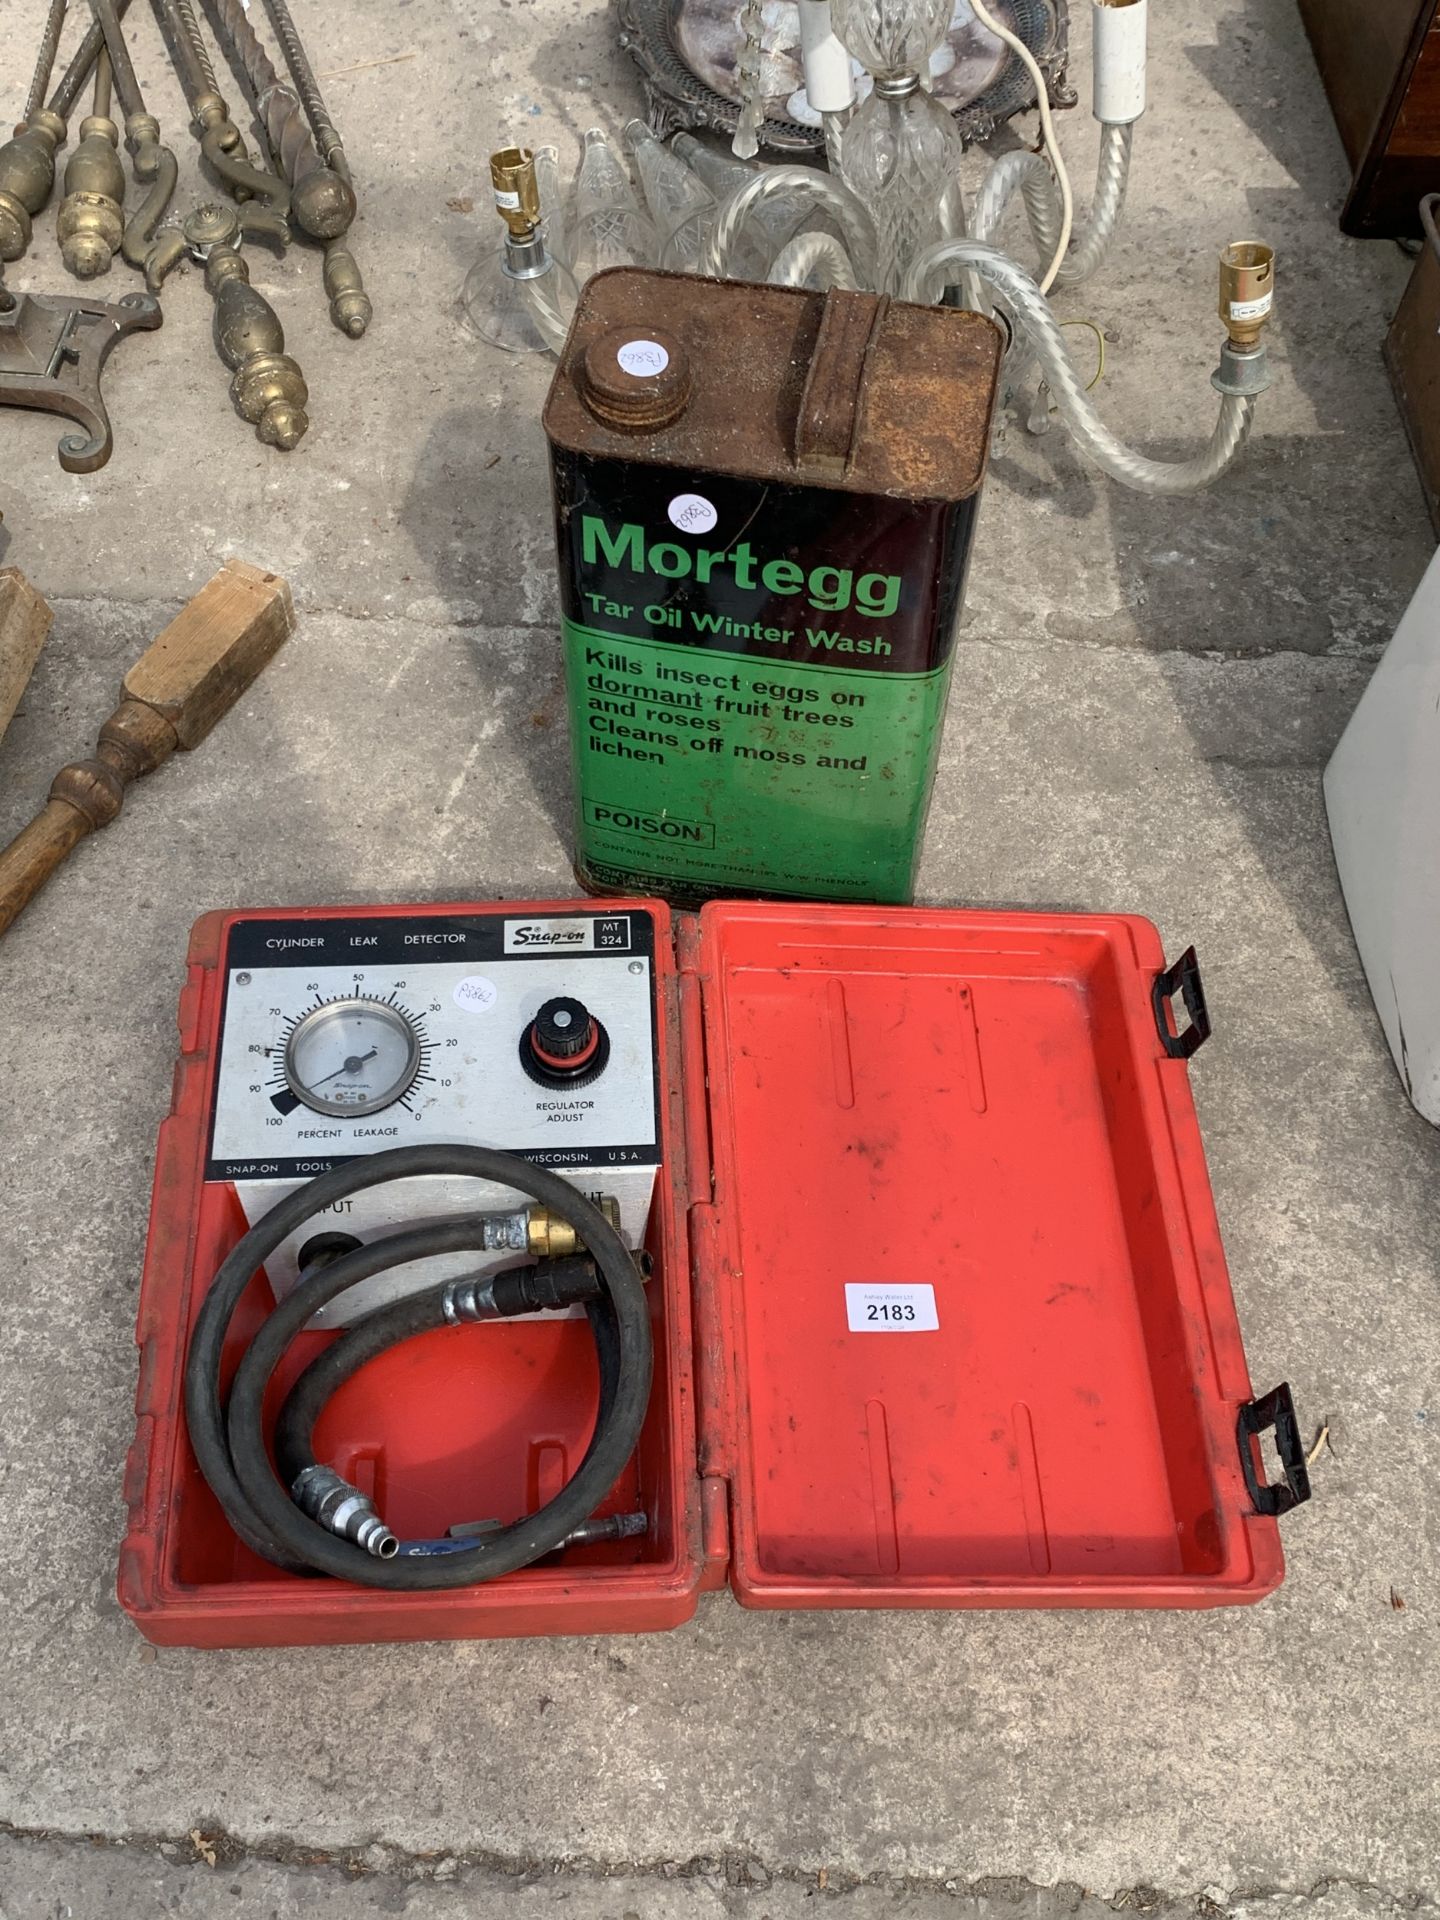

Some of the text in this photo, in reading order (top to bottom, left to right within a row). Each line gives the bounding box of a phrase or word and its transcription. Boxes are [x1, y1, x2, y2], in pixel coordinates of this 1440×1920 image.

[582, 515, 901, 618] Mortegg
[585, 593, 892, 656] Tar Oil Winter Wash
[586, 648, 865, 707] Kills insect eggs on
[588, 674, 855, 728] dormant fruit trees
[588, 696, 721, 732] and roses
[589, 715, 867, 771] Cleans off moss and
[589, 736, 664, 765] lichen
[594, 807, 702, 841] POISON
[594, 841, 651, 858] CONTAINS
[656, 855, 680, 865] NOT
[686, 858, 716, 870] MORE
[722, 864, 755, 874] THAN
[601, 922, 620, 932] MT
[512, 926, 586, 945] Snap-on
[601, 935, 622, 945] 324
[266, 934, 467, 949] CYLINDER LEAK DETECTOR
[352, 973, 365, 982] 50
[306, 983, 319, 991] 60
[394, 981, 406, 989] 40
[269, 1008, 281, 1016] 70
[429, 1003, 442, 1012] 30
[446, 1038, 458, 1047] 20
[248, 1044, 261, 1053] 80
[249, 1084, 261, 1093] 90
[440, 1079, 452, 1087] 10
[536, 1100, 595, 1111] REGULATOR
[265, 1118, 283, 1126] 100
[414, 1112, 422, 1121] 0
[546, 1113, 584, 1122] ADJUST
[297, 1127, 399, 1139] PERCENT LEAKAGE
[225, 1164, 279, 1174] SNAP-ON
[295, 1162, 332, 1172] TOOLS
[608, 1152, 642, 1161] U.S.A.
[867, 1304, 916, 1321] 2183
